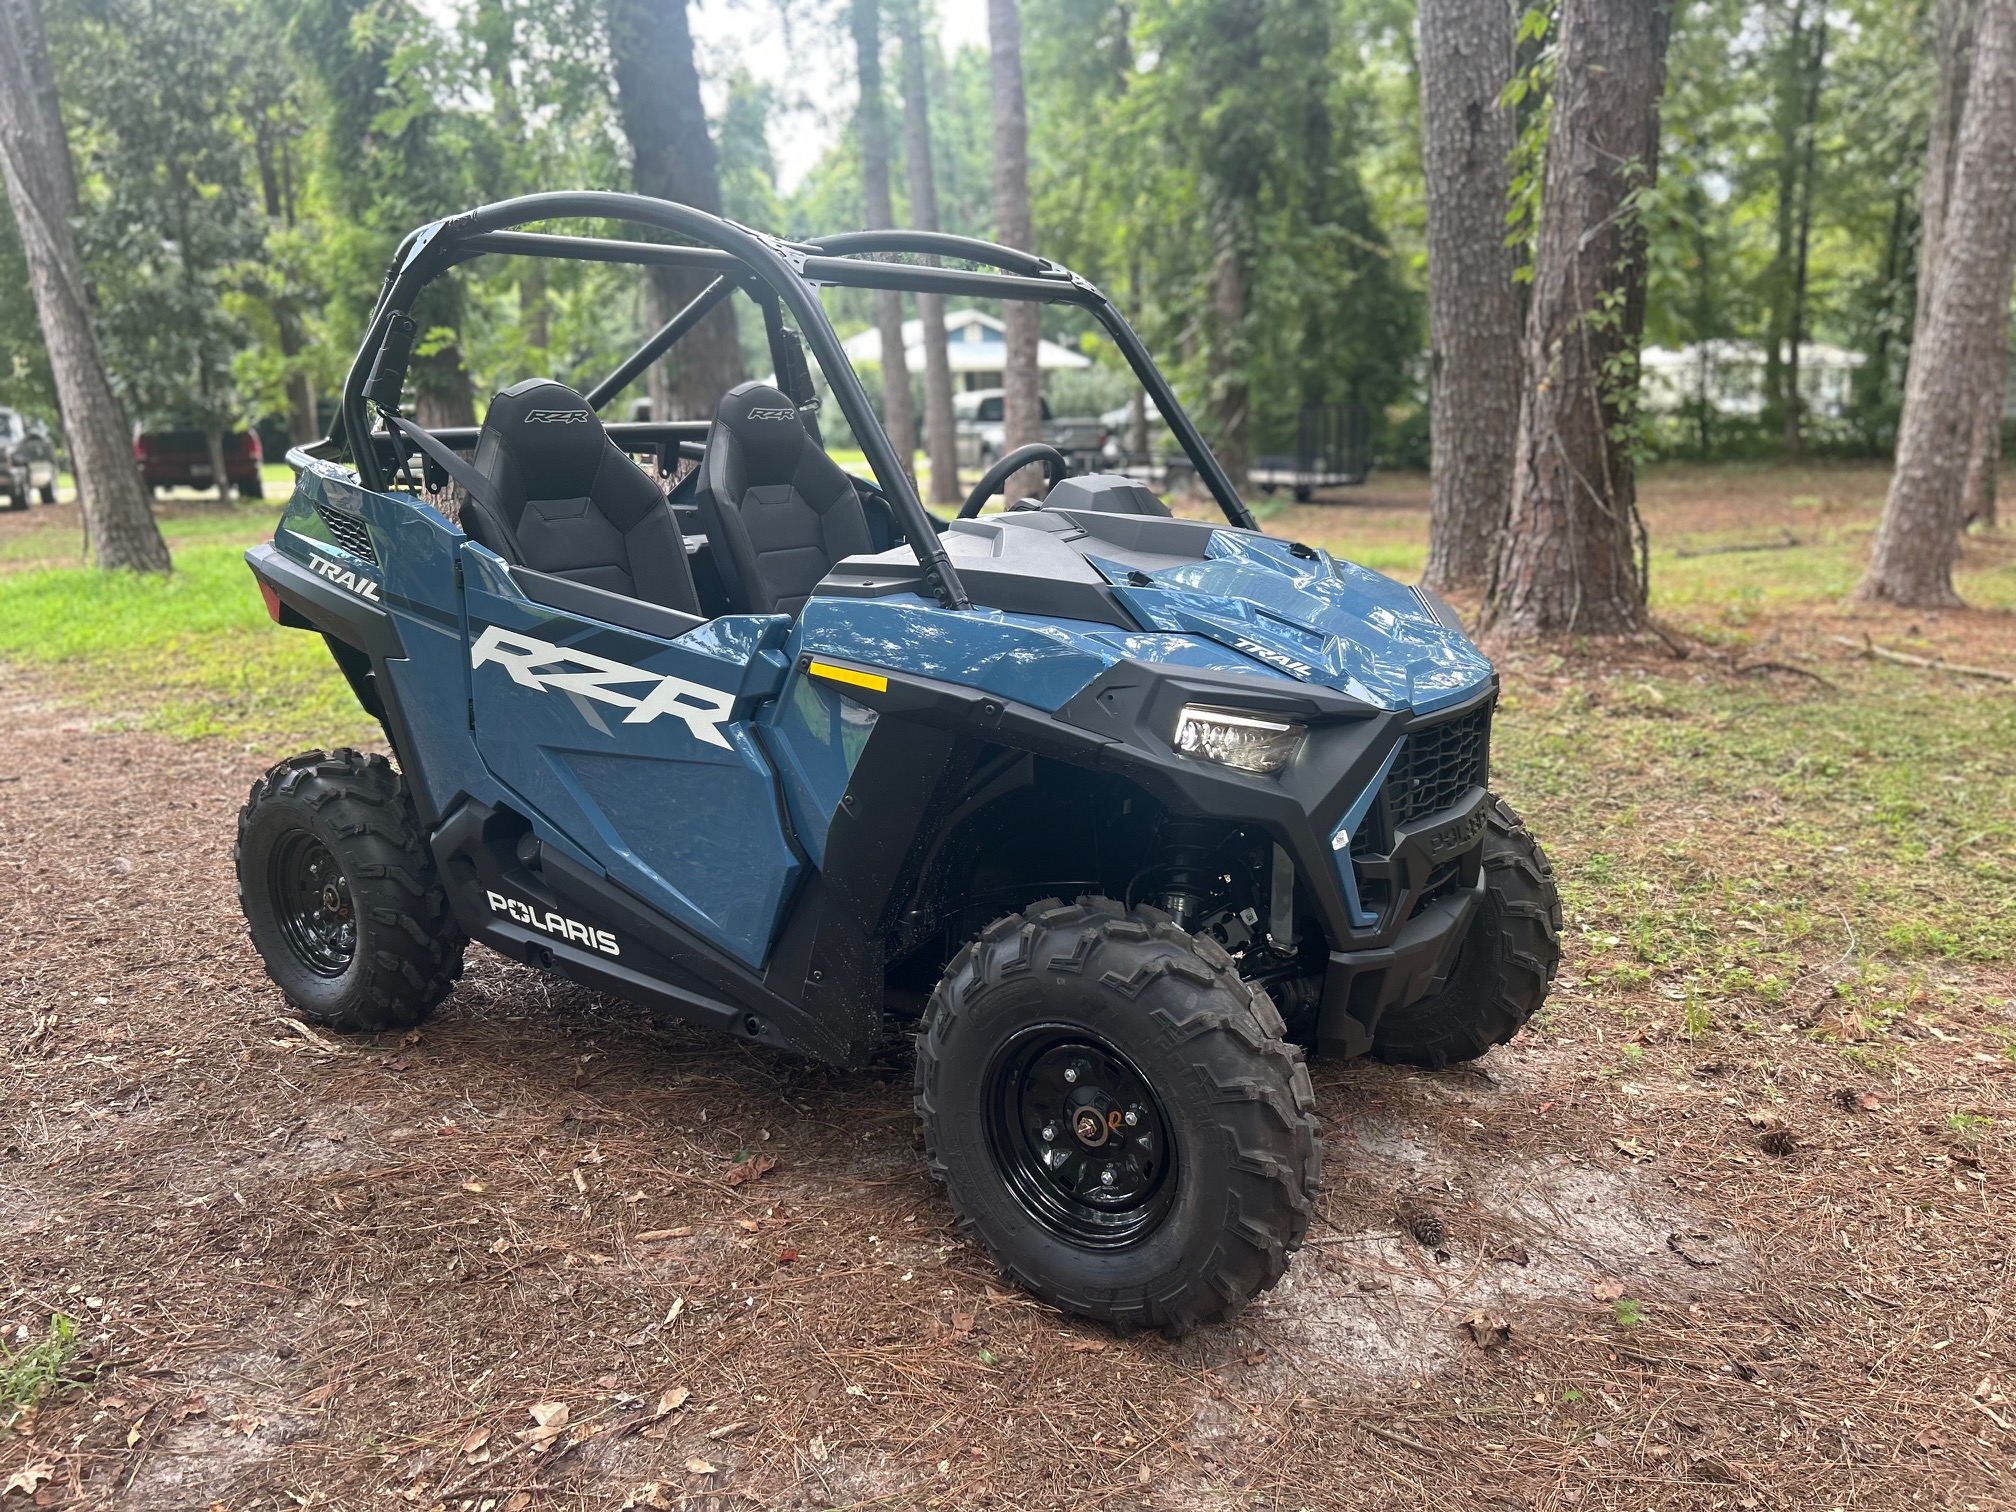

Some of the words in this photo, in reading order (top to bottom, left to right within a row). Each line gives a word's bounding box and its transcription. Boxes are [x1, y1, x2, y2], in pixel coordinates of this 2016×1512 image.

[525, 409, 588, 424] RZR
[748, 407, 795, 420] RZR
[308, 552, 381, 602] TRAIL
[1234, 637, 1313, 677] TRAIL
[471, 624, 737, 752] RZR
[1430, 805, 1488, 857] POLARIS
[486, 890, 621, 956] POLARIS
